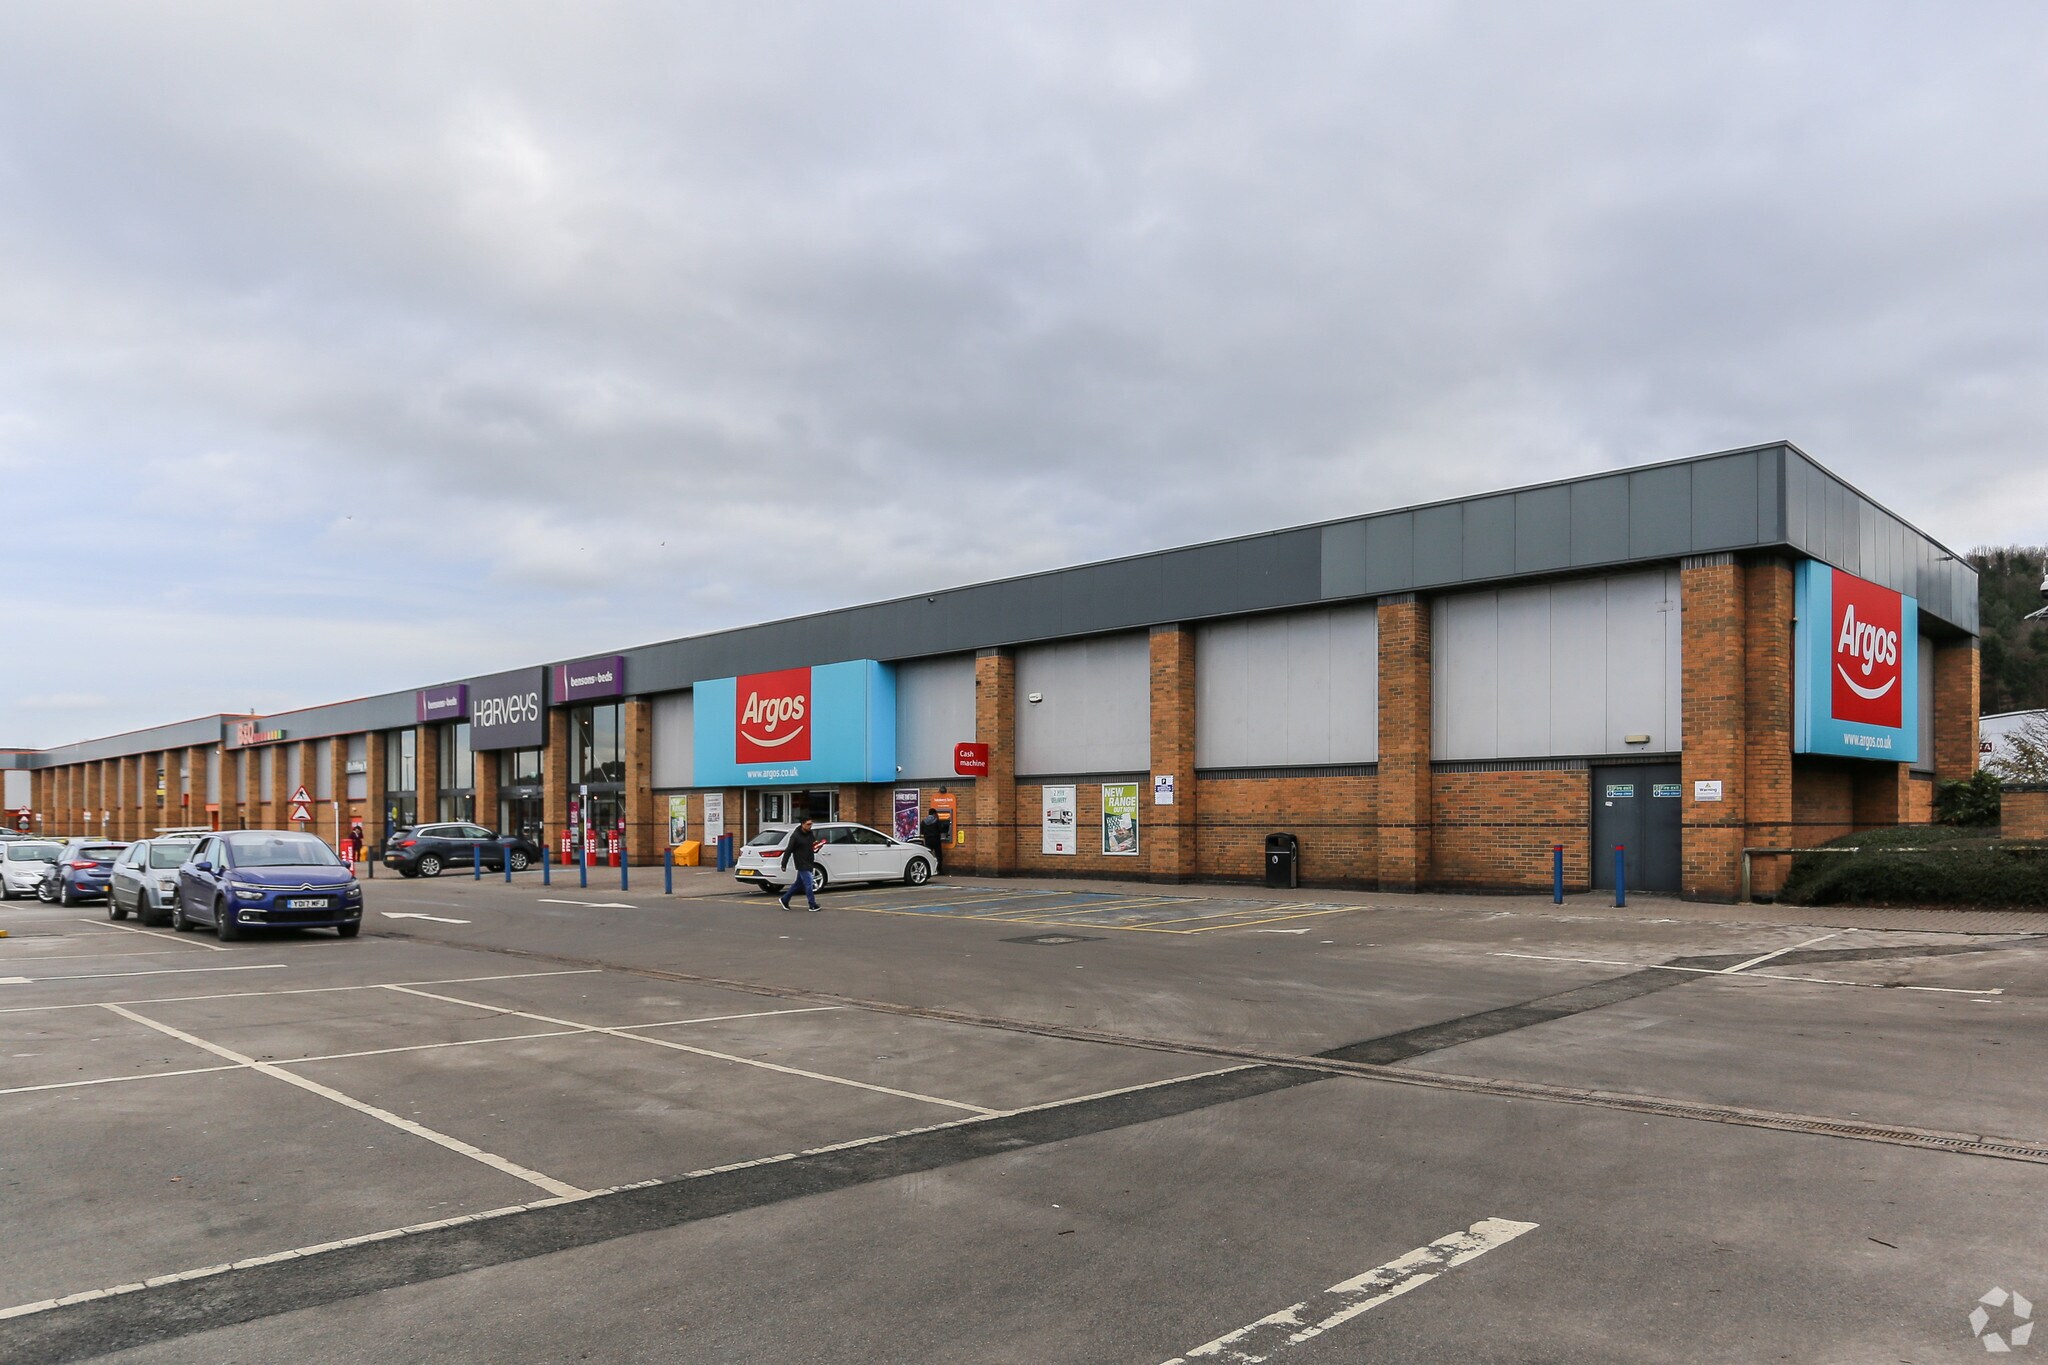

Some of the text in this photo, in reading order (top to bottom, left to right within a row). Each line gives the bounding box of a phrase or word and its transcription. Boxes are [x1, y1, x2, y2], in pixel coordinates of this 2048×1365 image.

[1838, 604, 1897, 676] Argos
[741, 691, 805, 733] Argos
[1843, 733, 1892, 751] www.argos.co.uk
[960, 750, 974, 758] Cash
[960, 760, 986, 768] machine
[747, 767, 799, 780] www.argos.co.uk
[1105, 788, 1124, 797] NEW
[1109, 797, 1136, 806] RANGE
